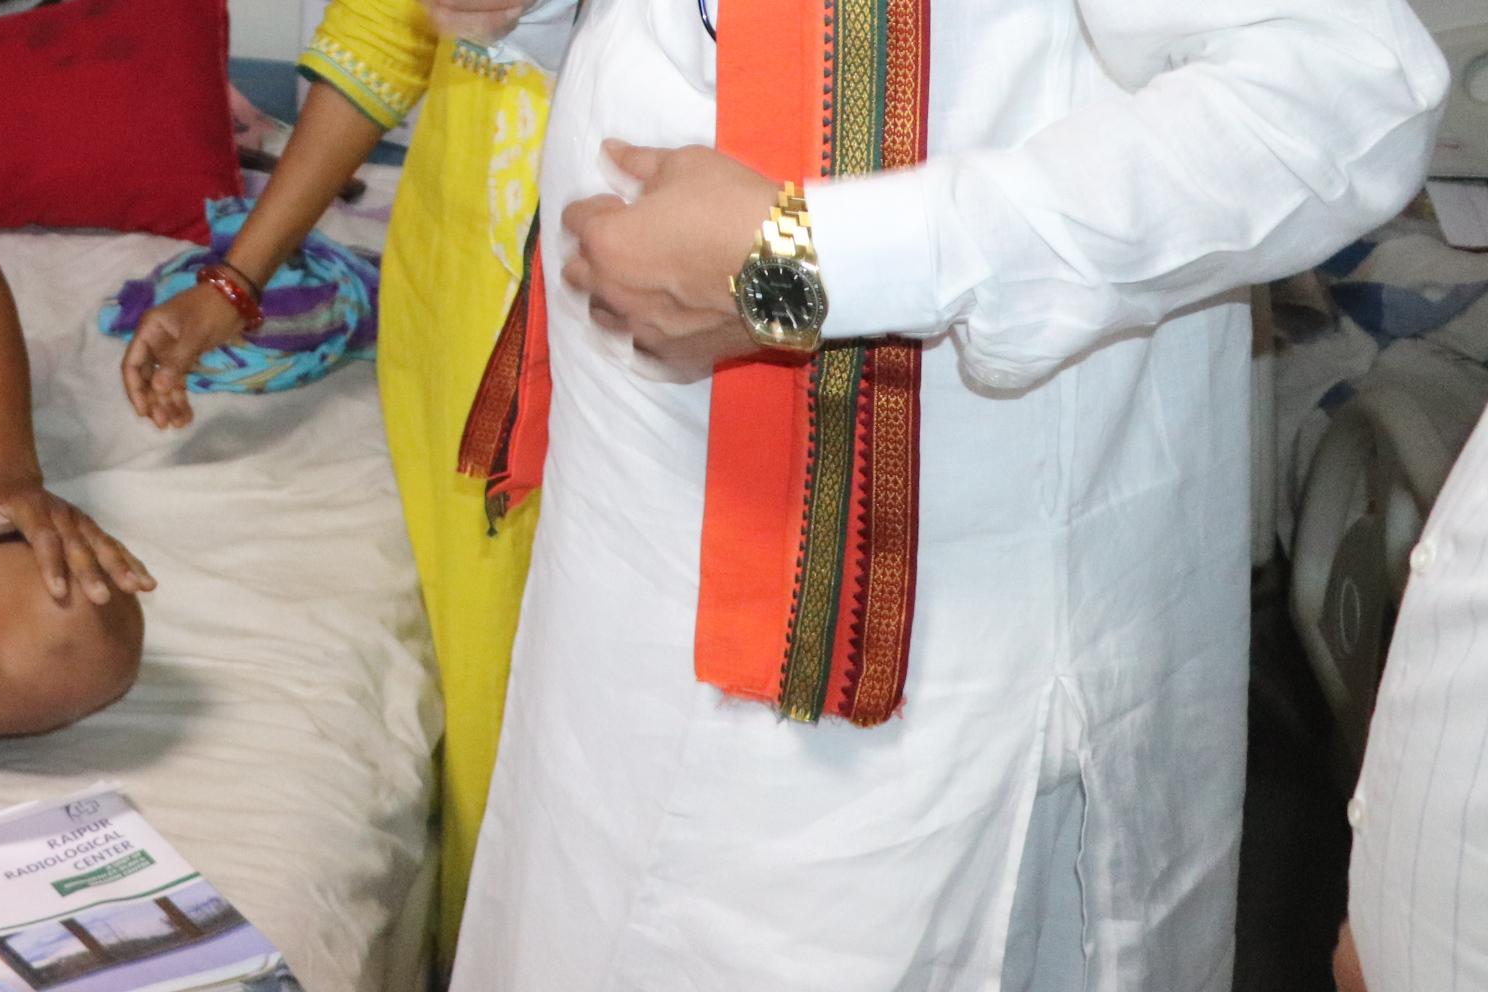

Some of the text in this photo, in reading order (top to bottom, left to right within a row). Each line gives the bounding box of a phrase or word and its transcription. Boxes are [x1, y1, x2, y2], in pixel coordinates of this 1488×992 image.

[46, 817, 113, 849] RAIPUR
[3, 830, 125, 880] RADIOLOGICAL
[72, 840, 135, 871] CENTER
